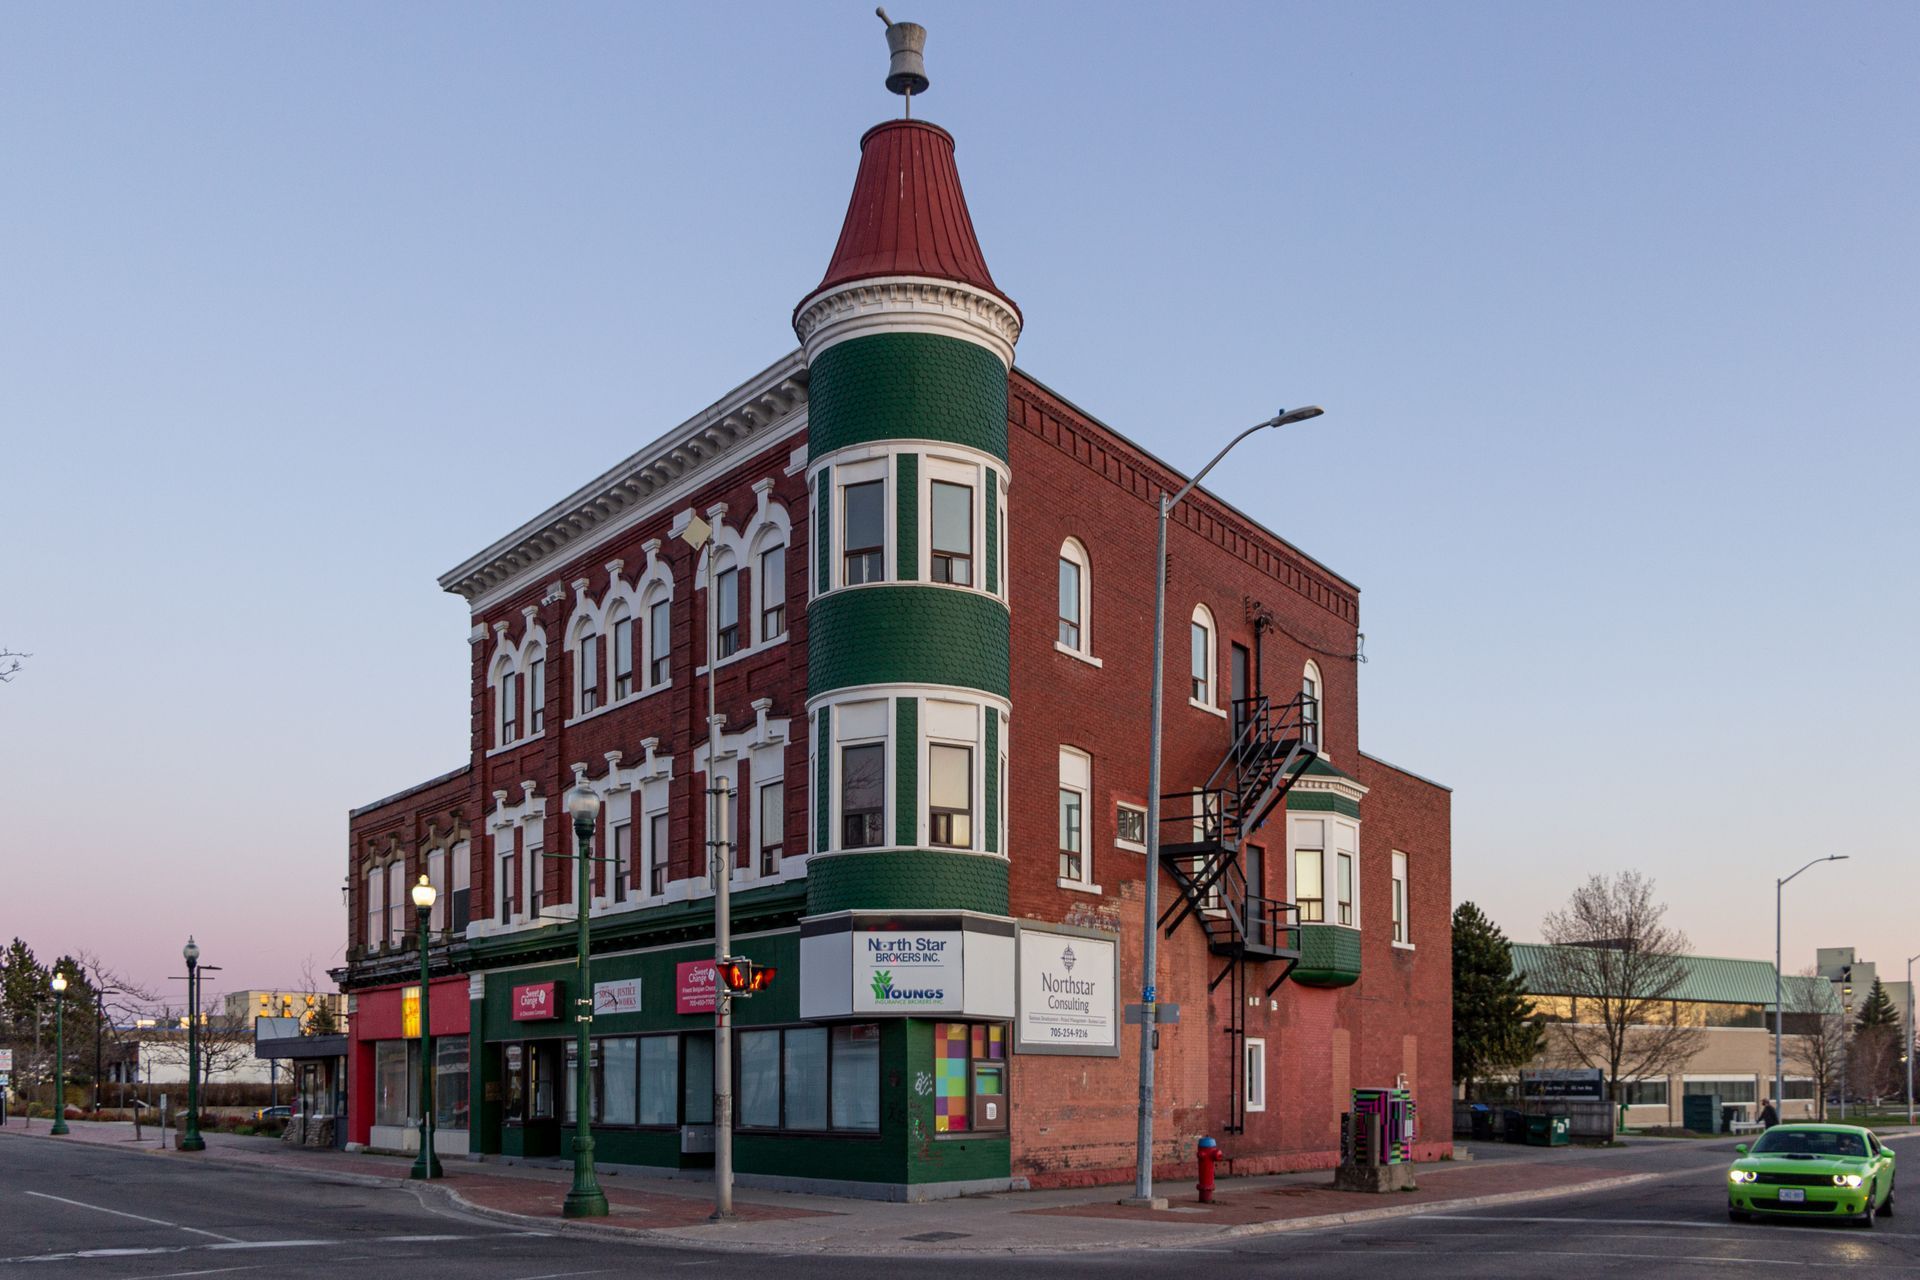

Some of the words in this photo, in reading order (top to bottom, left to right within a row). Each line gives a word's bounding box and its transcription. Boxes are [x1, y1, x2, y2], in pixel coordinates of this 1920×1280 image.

[868, 938, 912, 951] North
[916, 938, 947, 951] Star
[876, 953, 921, 962] BROKERS
[923, 953, 940, 962] INC.
[694, 966, 709, 977] Sweet
[689, 973, 707, 985] Change
[1042, 972, 1095, 995] Northstar
[526, 987, 540, 998] Sweet
[617, 986, 635, 997] JUSTICE
[882, 984, 944, 999] YOUNGS
[520, 995, 538, 1008] Change
[1048, 995, 1089, 1014] Consulting
[1050, 1027, 1088, 1038] 705-254-9216
